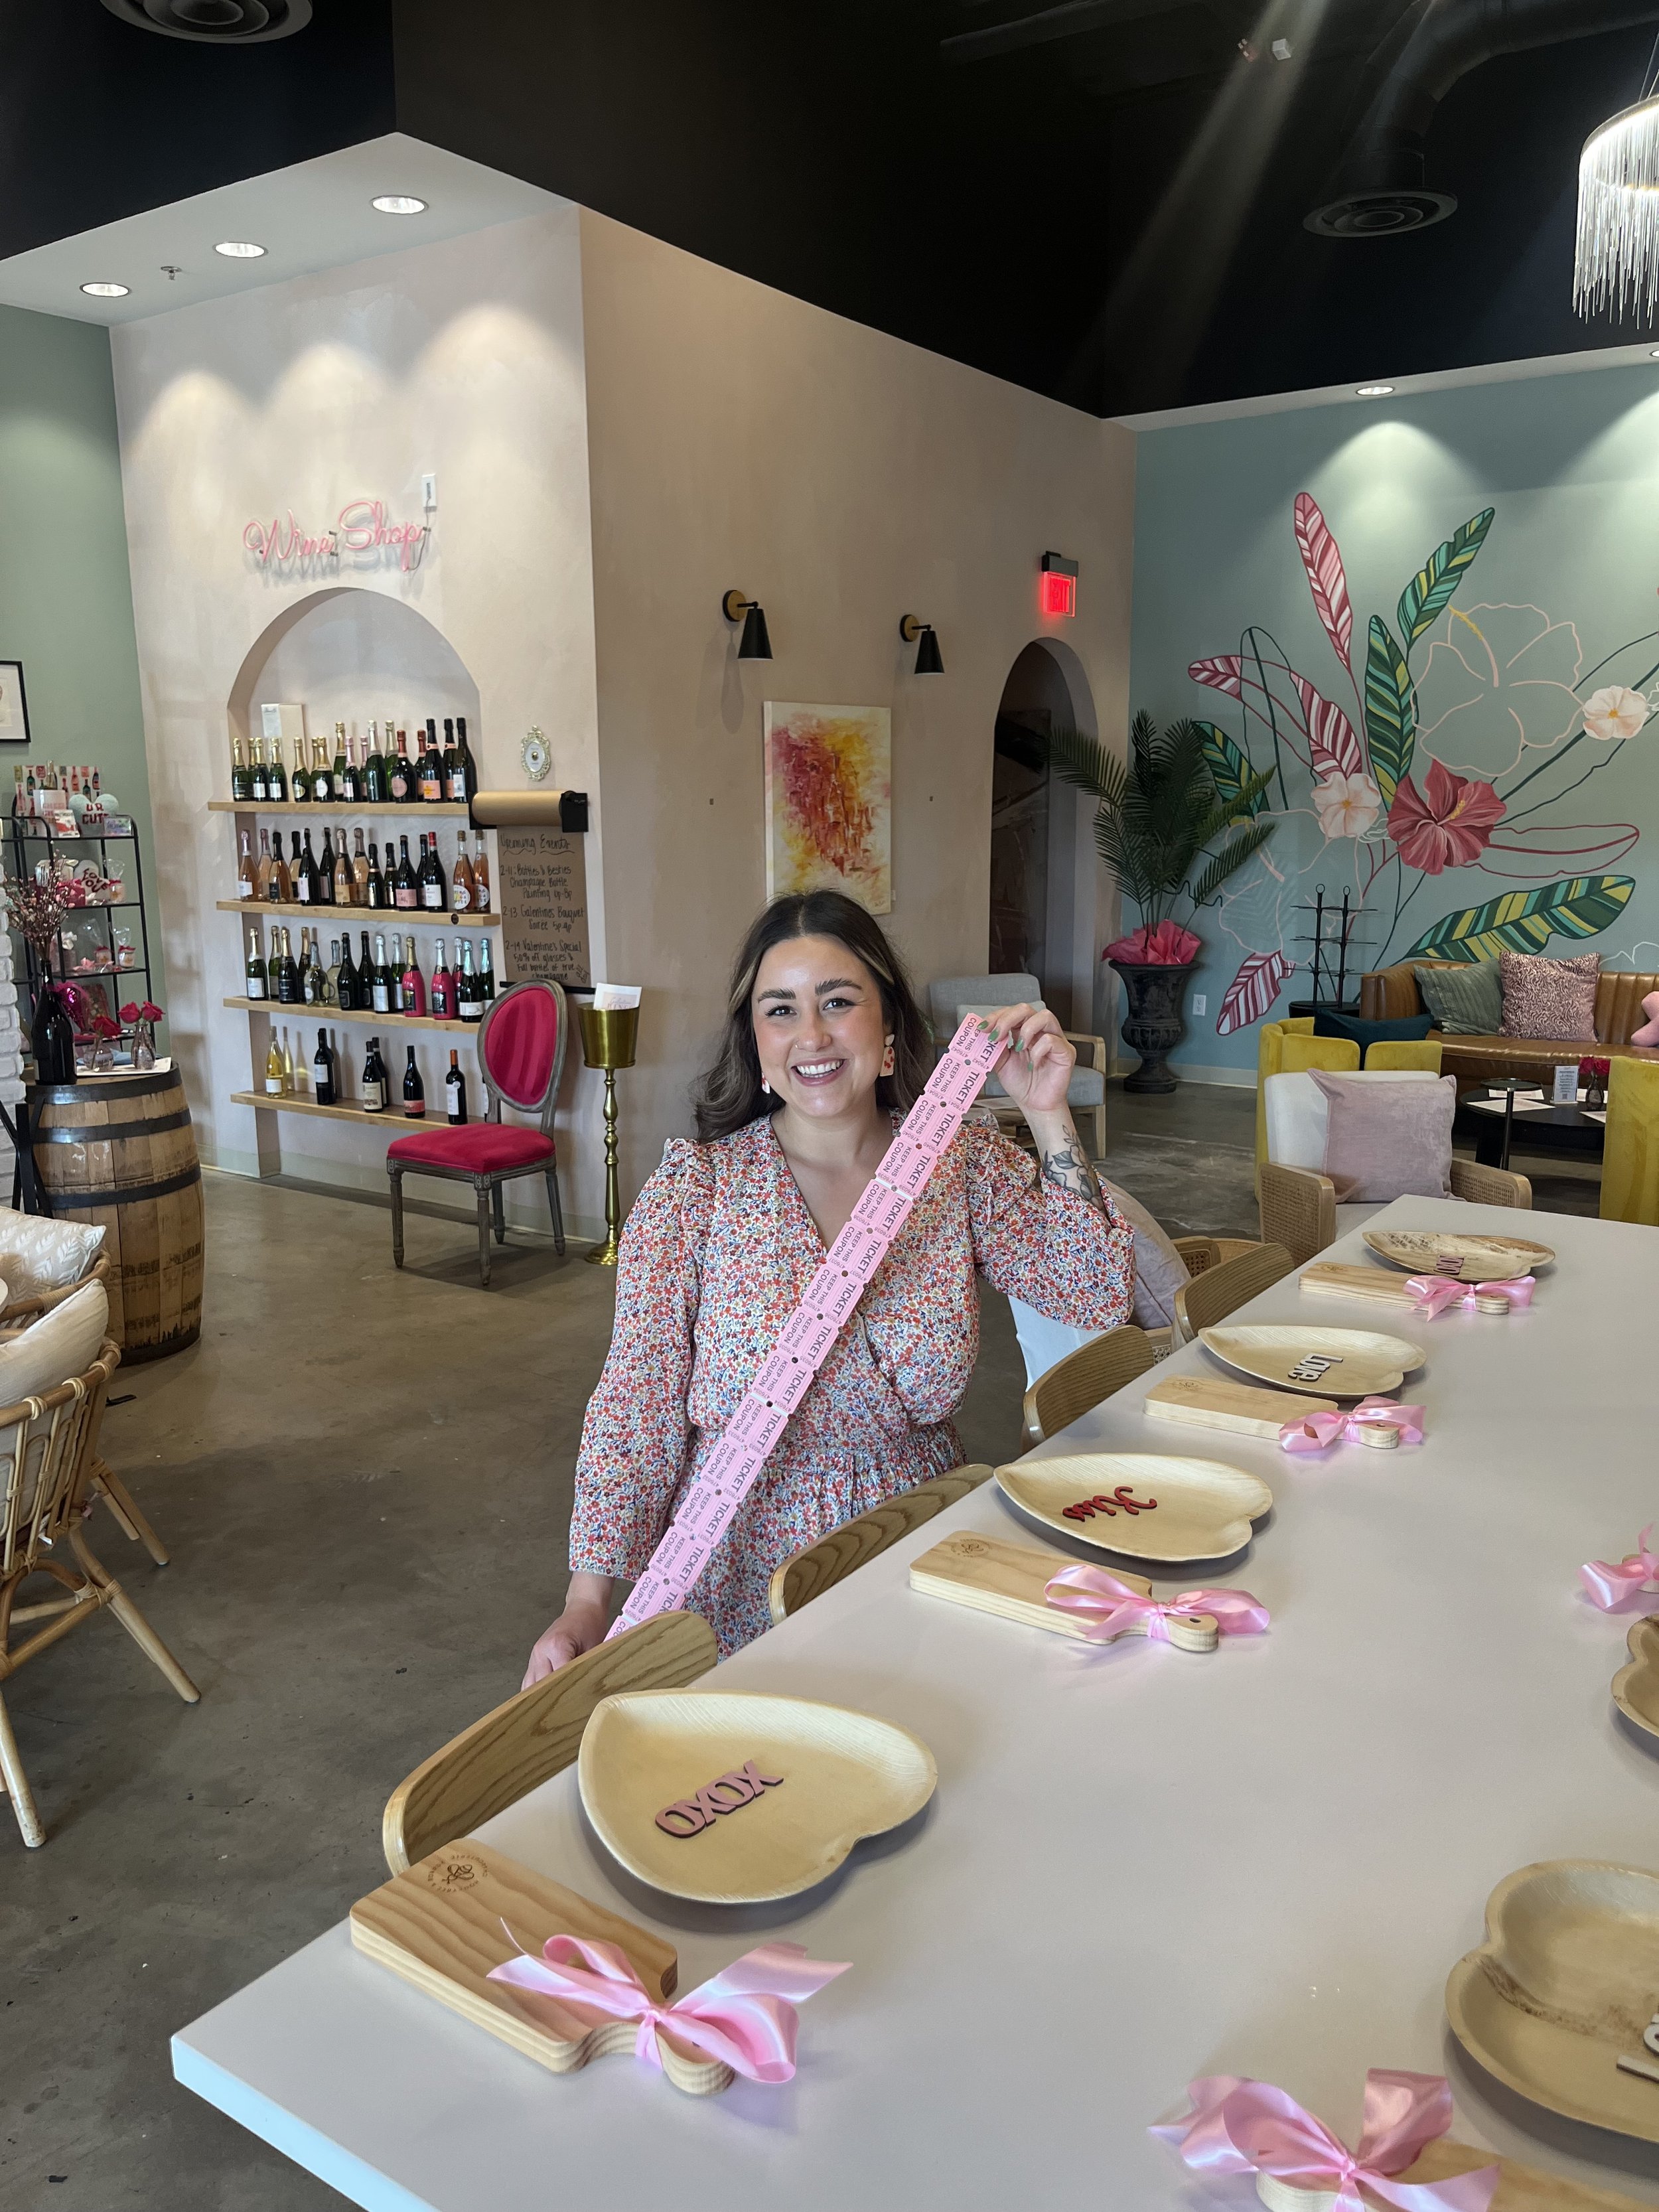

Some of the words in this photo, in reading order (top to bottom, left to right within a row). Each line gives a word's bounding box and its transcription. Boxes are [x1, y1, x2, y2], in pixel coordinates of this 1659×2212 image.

[243, 509, 335, 562] Wine
[338, 500, 424, 571] Shop
[540, 834, 571, 849] Events
[518, 863, 540, 875] Bottles
[547, 865, 571, 875] Besties
[510, 877, 545, 889] Champagne
[549, 877, 569, 887] Bottle
[523, 888, 550, 902] Painting
[559, 940, 581, 952] Special
[514, 952, 530, 962] 50%
[543, 953, 566, 966] glasses
[956, 1017, 977, 1047] COUPON
[964, 1037, 975, 1051] THIS
[932, 1058, 953, 1088] COUPON
[949, 1062, 961, 1079] KEEP
[940, 1079, 952, 1092] THIS
[956, 1071, 980, 1104] TICKET
[907, 1100, 928, 1130] COUPON
[924, 1104, 936, 1121] KEEP
[916, 1121, 927, 1135] THIS
[931, 1113, 956, 1146] TICKET
[883, 1142, 904, 1173] COUPON
[901, 1146, 912, 1163] KEEP
[891, 1163, 902, 1177] THIS
[906, 1155, 931, 1189] TICKET
[858, 1184, 879, 1215] COUPON
[876, 1188, 887, 1205] KEEP
[867, 1205, 878, 1219] THIS
[882, 1197, 906, 1231] TICKET
[833, 1226, 855, 1258] COUPON
[851, 1230, 863, 1248] KEEP
[842, 1248, 853, 1262] THIS
[857, 1240, 882, 1274] TICKET
[808, 1269, 830, 1300] COUPON
[826, 1274, 838, 1291] KEEP
[817, 1291, 828, 1305] THIS
[832, 1283, 857, 1317] TICKET
[784, 1312, 805, 1343] COUPON
[801, 1316, 813, 1334] KEEP
[792, 1334, 804, 1348] THIS
[808, 1326, 832, 1361] TICKET
[758, 1355, 780, 1387] COUPON
[776, 1360, 788, 1377] KEEP
[1288, 1353, 1343, 1382] Love
[767, 1378, 778, 1392] THIS
[782, 1370, 807, 1404] TICKET
[733, 1398, 755, 1431] COUPON
[751, 1404, 763, 1421] KEEP
[741, 1422, 753, 1436] THIS
[757, 1413, 782, 1449] TICKET
[707, 1443, 729, 1475] COUPON
[725, 1447, 737, 1465] KEEP
[716, 1466, 727, 1480] THIS
[731, 1457, 756, 1493] TICKET
[682, 1487, 703, 1520] COUPON
[699, 1492, 711, 1510] KEEP
[1062, 1486, 1157, 1522] Kiss
[690, 1510, 701, 1524] THIS
[705, 1503, 730, 1538] TICKET
[656, 1532, 678, 1564] COUPON
[674, 1536, 685, 1554] KEEP
[664, 1555, 676, 1569] THIS
[679, 1547, 704, 1582] TICKET
[630, 1576, 652, 1609] COUPON
[648, 1582, 660, 1599] KEEP
[638, 1599, 650, 1614] THIS
[659, 1591, 678, 1612] TICK
